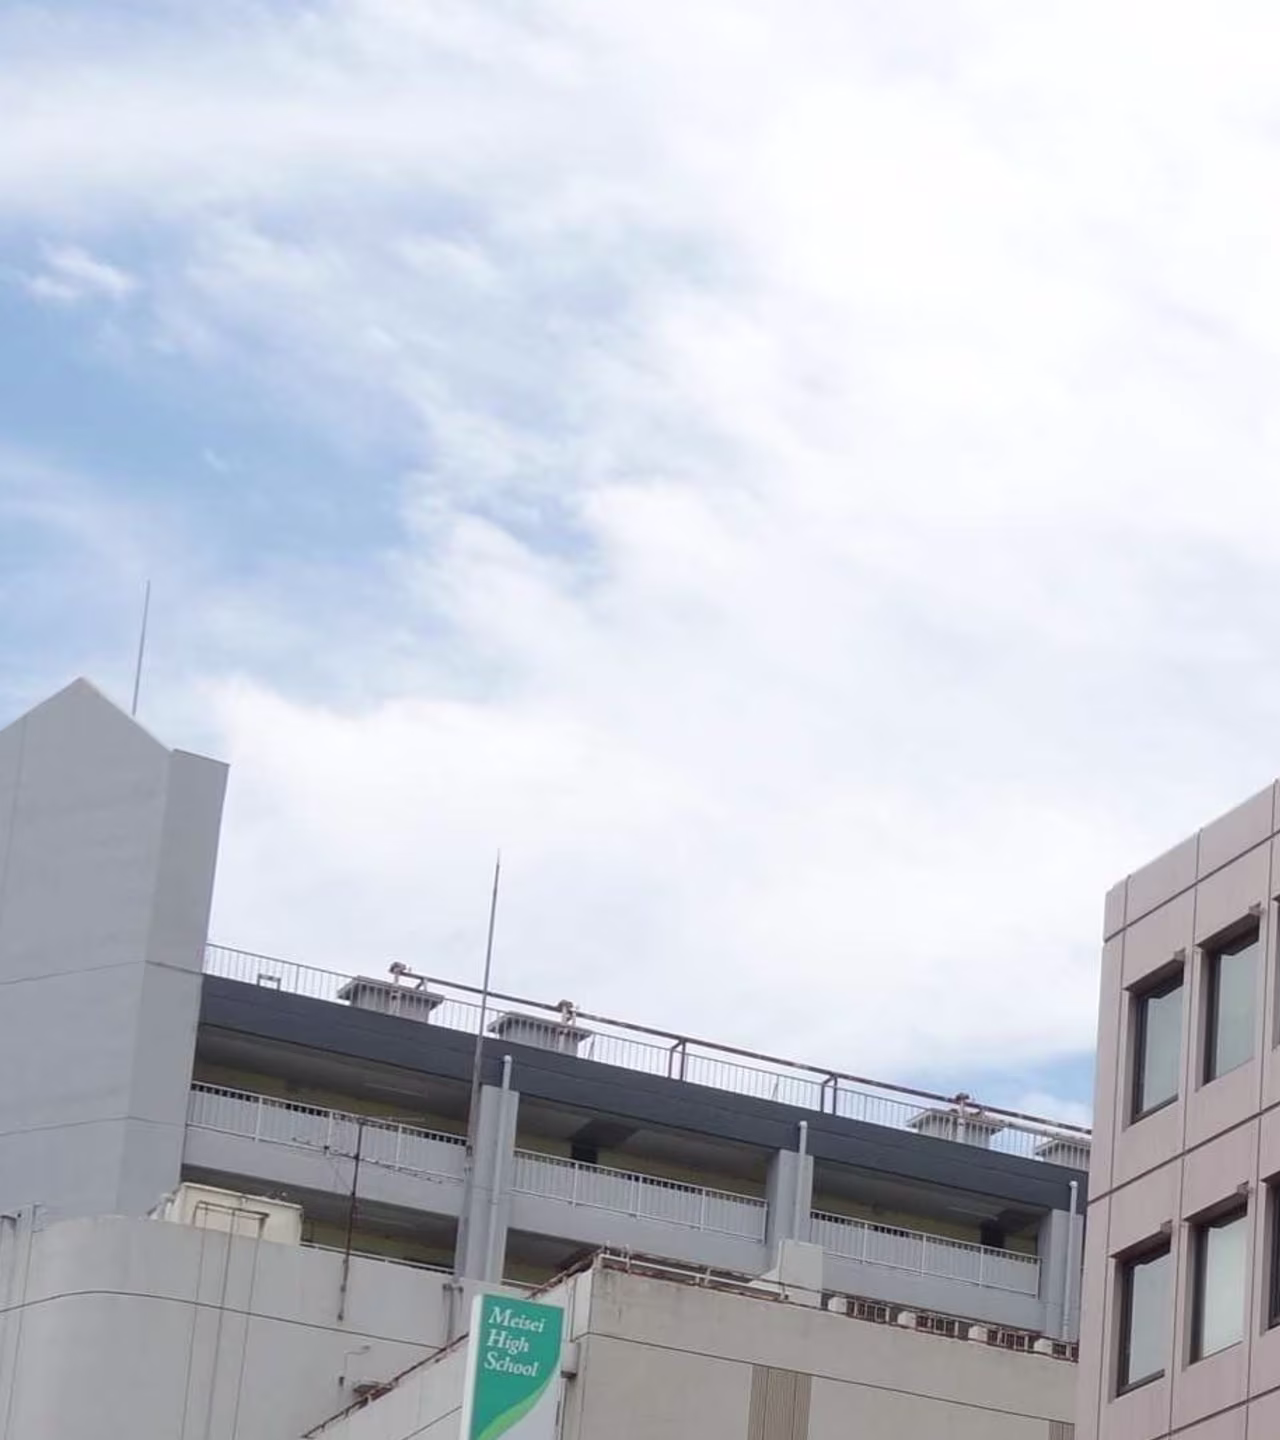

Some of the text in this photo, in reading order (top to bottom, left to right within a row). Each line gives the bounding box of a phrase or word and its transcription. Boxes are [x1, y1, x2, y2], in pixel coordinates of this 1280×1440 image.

[488, 1306, 545, 1333] Meisei
[486, 1328, 529, 1354] High
[484, 1351, 540, 1377] School
